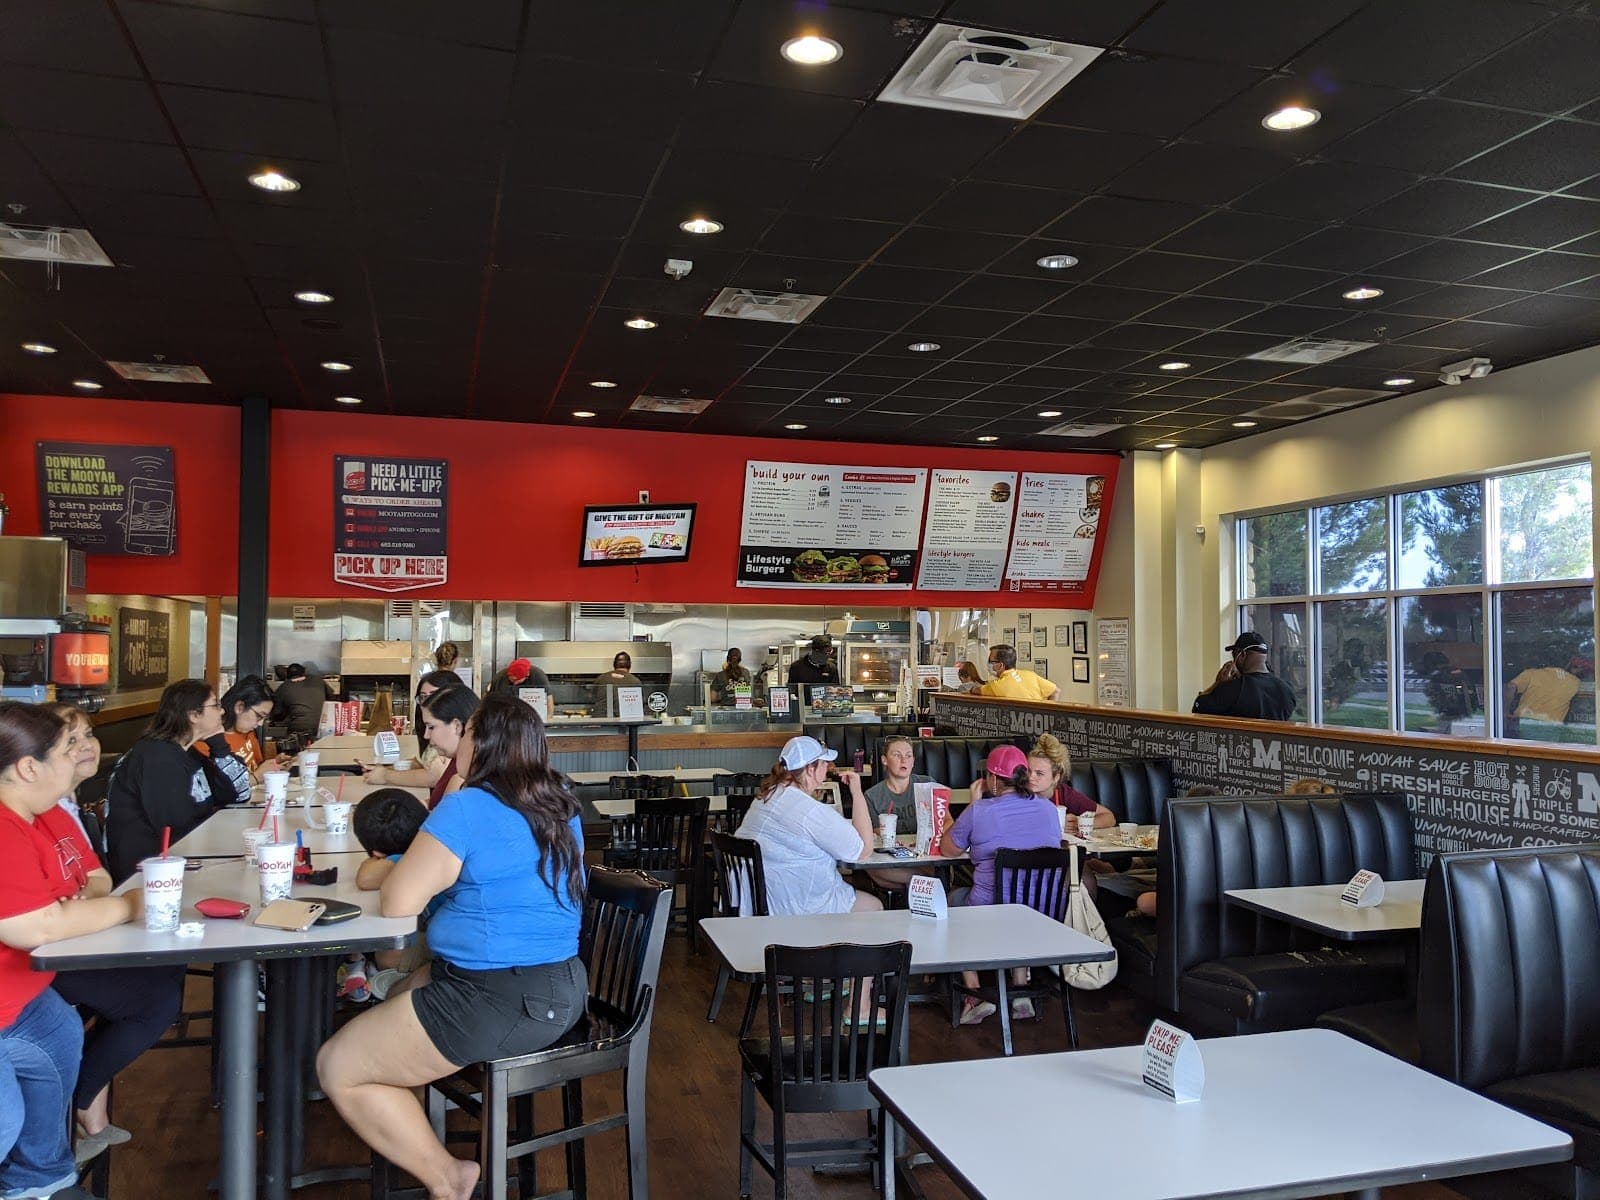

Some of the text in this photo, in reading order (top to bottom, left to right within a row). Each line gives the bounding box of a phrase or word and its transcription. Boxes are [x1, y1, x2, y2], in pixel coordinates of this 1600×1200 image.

[46, 455, 106, 470] DOWNLOAD
[46, 469, 116, 483] THE MOOYAH
[372, 463, 442, 480] NEED A LITTLE
[753, 467, 778, 479] build
[782, 472, 806, 482] your
[370, 478, 442, 494] PICK-ME-UP?
[938, 474, 970, 485] favorites
[1025, 476, 1045, 488] fries
[48, 482, 124, 496] REWARDS APP
[48, 500, 124, 512] & earn points
[50, 510, 102, 522] for every
[655, 512, 686, 520] MOOYAH
[50, 520, 102, 530] purchase
[746, 554, 792, 566] Lifestyle
[927, 550, 976, 559] lifestyle burgers
[336, 556, 444, 576] PICK UP HERE
[745, 564, 785, 574] Burgers
[1088, 720, 1197, 742] WELCOME MOOYAH SAUCE
[1145, 741, 1180, 758] FRESH
[1180, 750, 1218, 763] BURGERS
[1252, 738, 1282, 771] M
[1228, 757, 1251, 768] TRIPLE
[1283, 743, 1471, 774] WELCOME MOOYAH SAUCE
[1172, 758, 1218, 780] IN-HOUSE
[1245, 770, 1260, 778] SOME
[1473, 760, 1510, 778] HOT
[1380, 772, 1440, 794] FRESH
[1474, 774, 1510, 790] DOGS
[1442, 786, 1510, 804] BURGERS
[1406, 793, 1510, 826] DE IN-HOUSE
[1532, 798, 1573, 813] TRIPLE
[1532, 810, 1600, 829] DID SOME
[1414, 833, 1434, 848] MORE
[1152, 1025, 1170, 1038] SKIP
